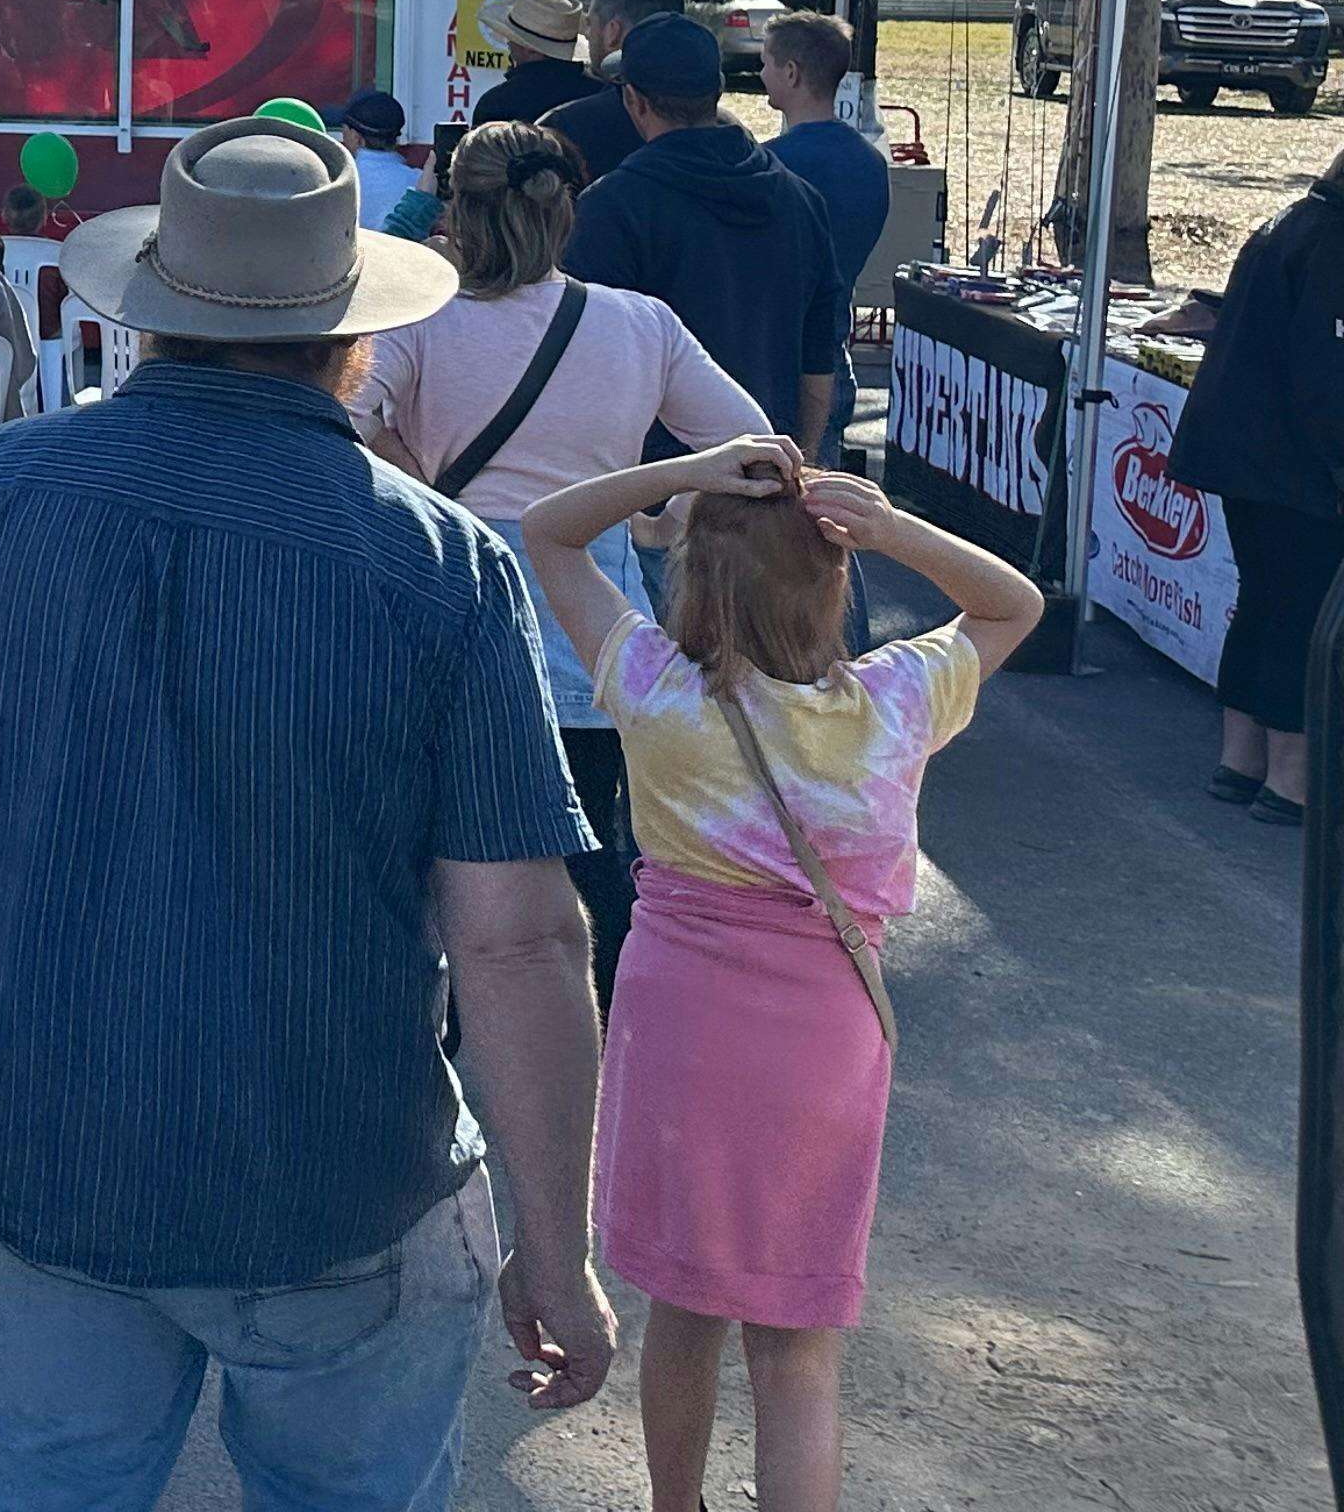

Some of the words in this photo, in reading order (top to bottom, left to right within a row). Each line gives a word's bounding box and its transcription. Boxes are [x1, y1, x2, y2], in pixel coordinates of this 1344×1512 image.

[465, 50, 504, 69] NEXT
[887, 321, 1049, 515] SUPERTANK
[1121, 454, 1199, 551] Berkley
